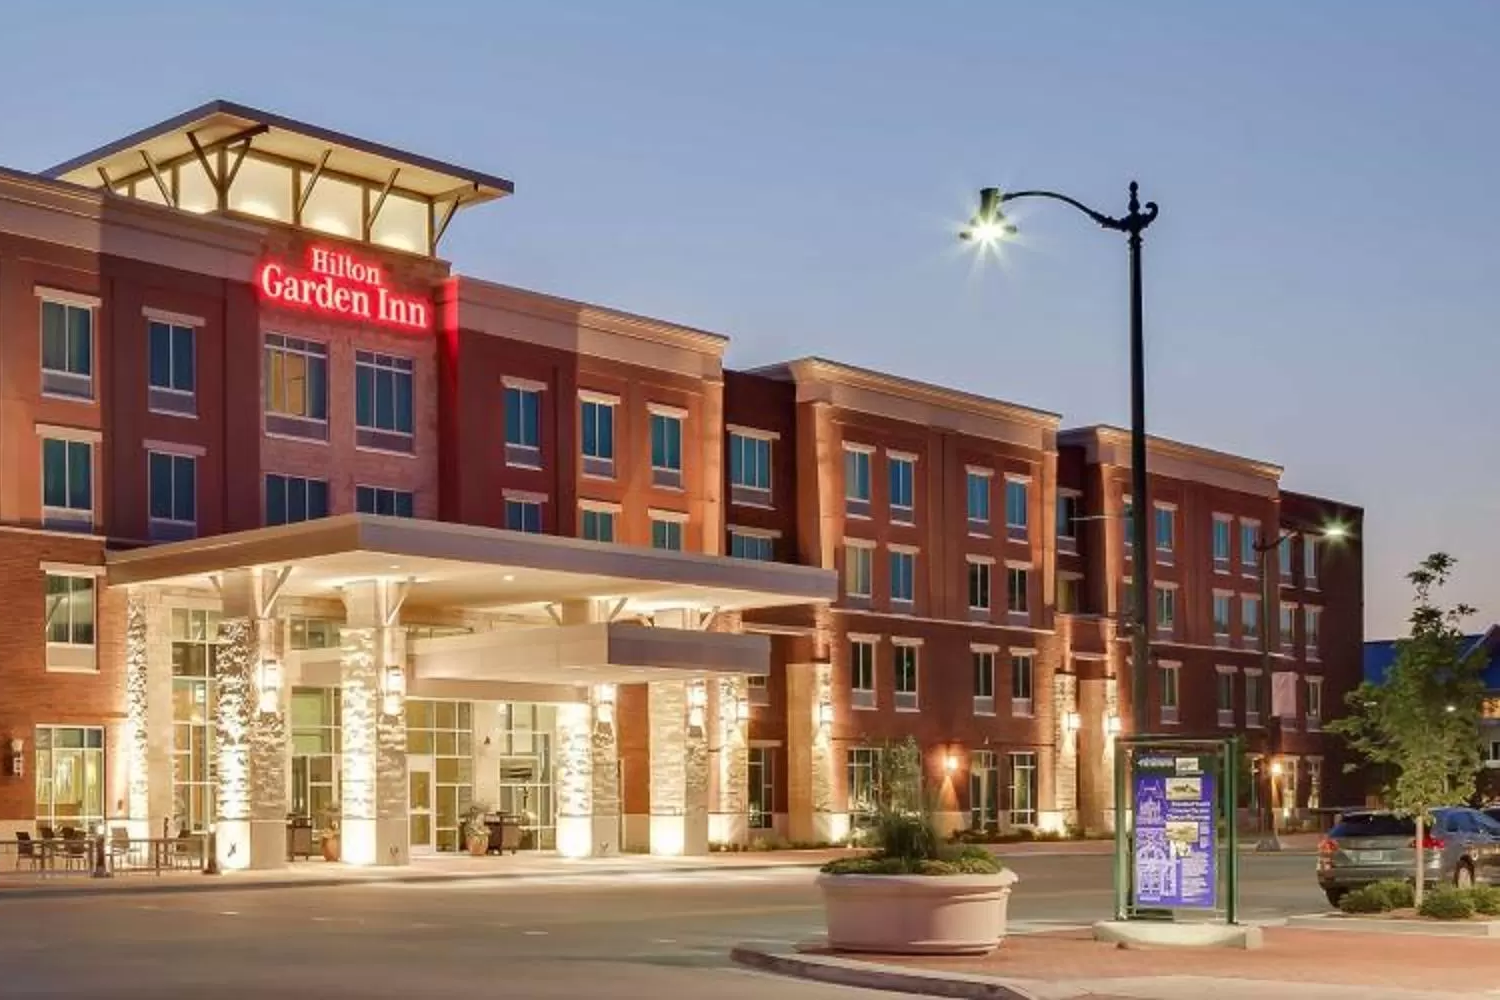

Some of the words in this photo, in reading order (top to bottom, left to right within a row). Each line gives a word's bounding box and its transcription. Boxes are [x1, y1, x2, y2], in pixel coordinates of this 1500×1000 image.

[311, 247, 381, 284] Hilton
[261, 263, 371, 317] Garden
[378, 287, 428, 328] Inn
